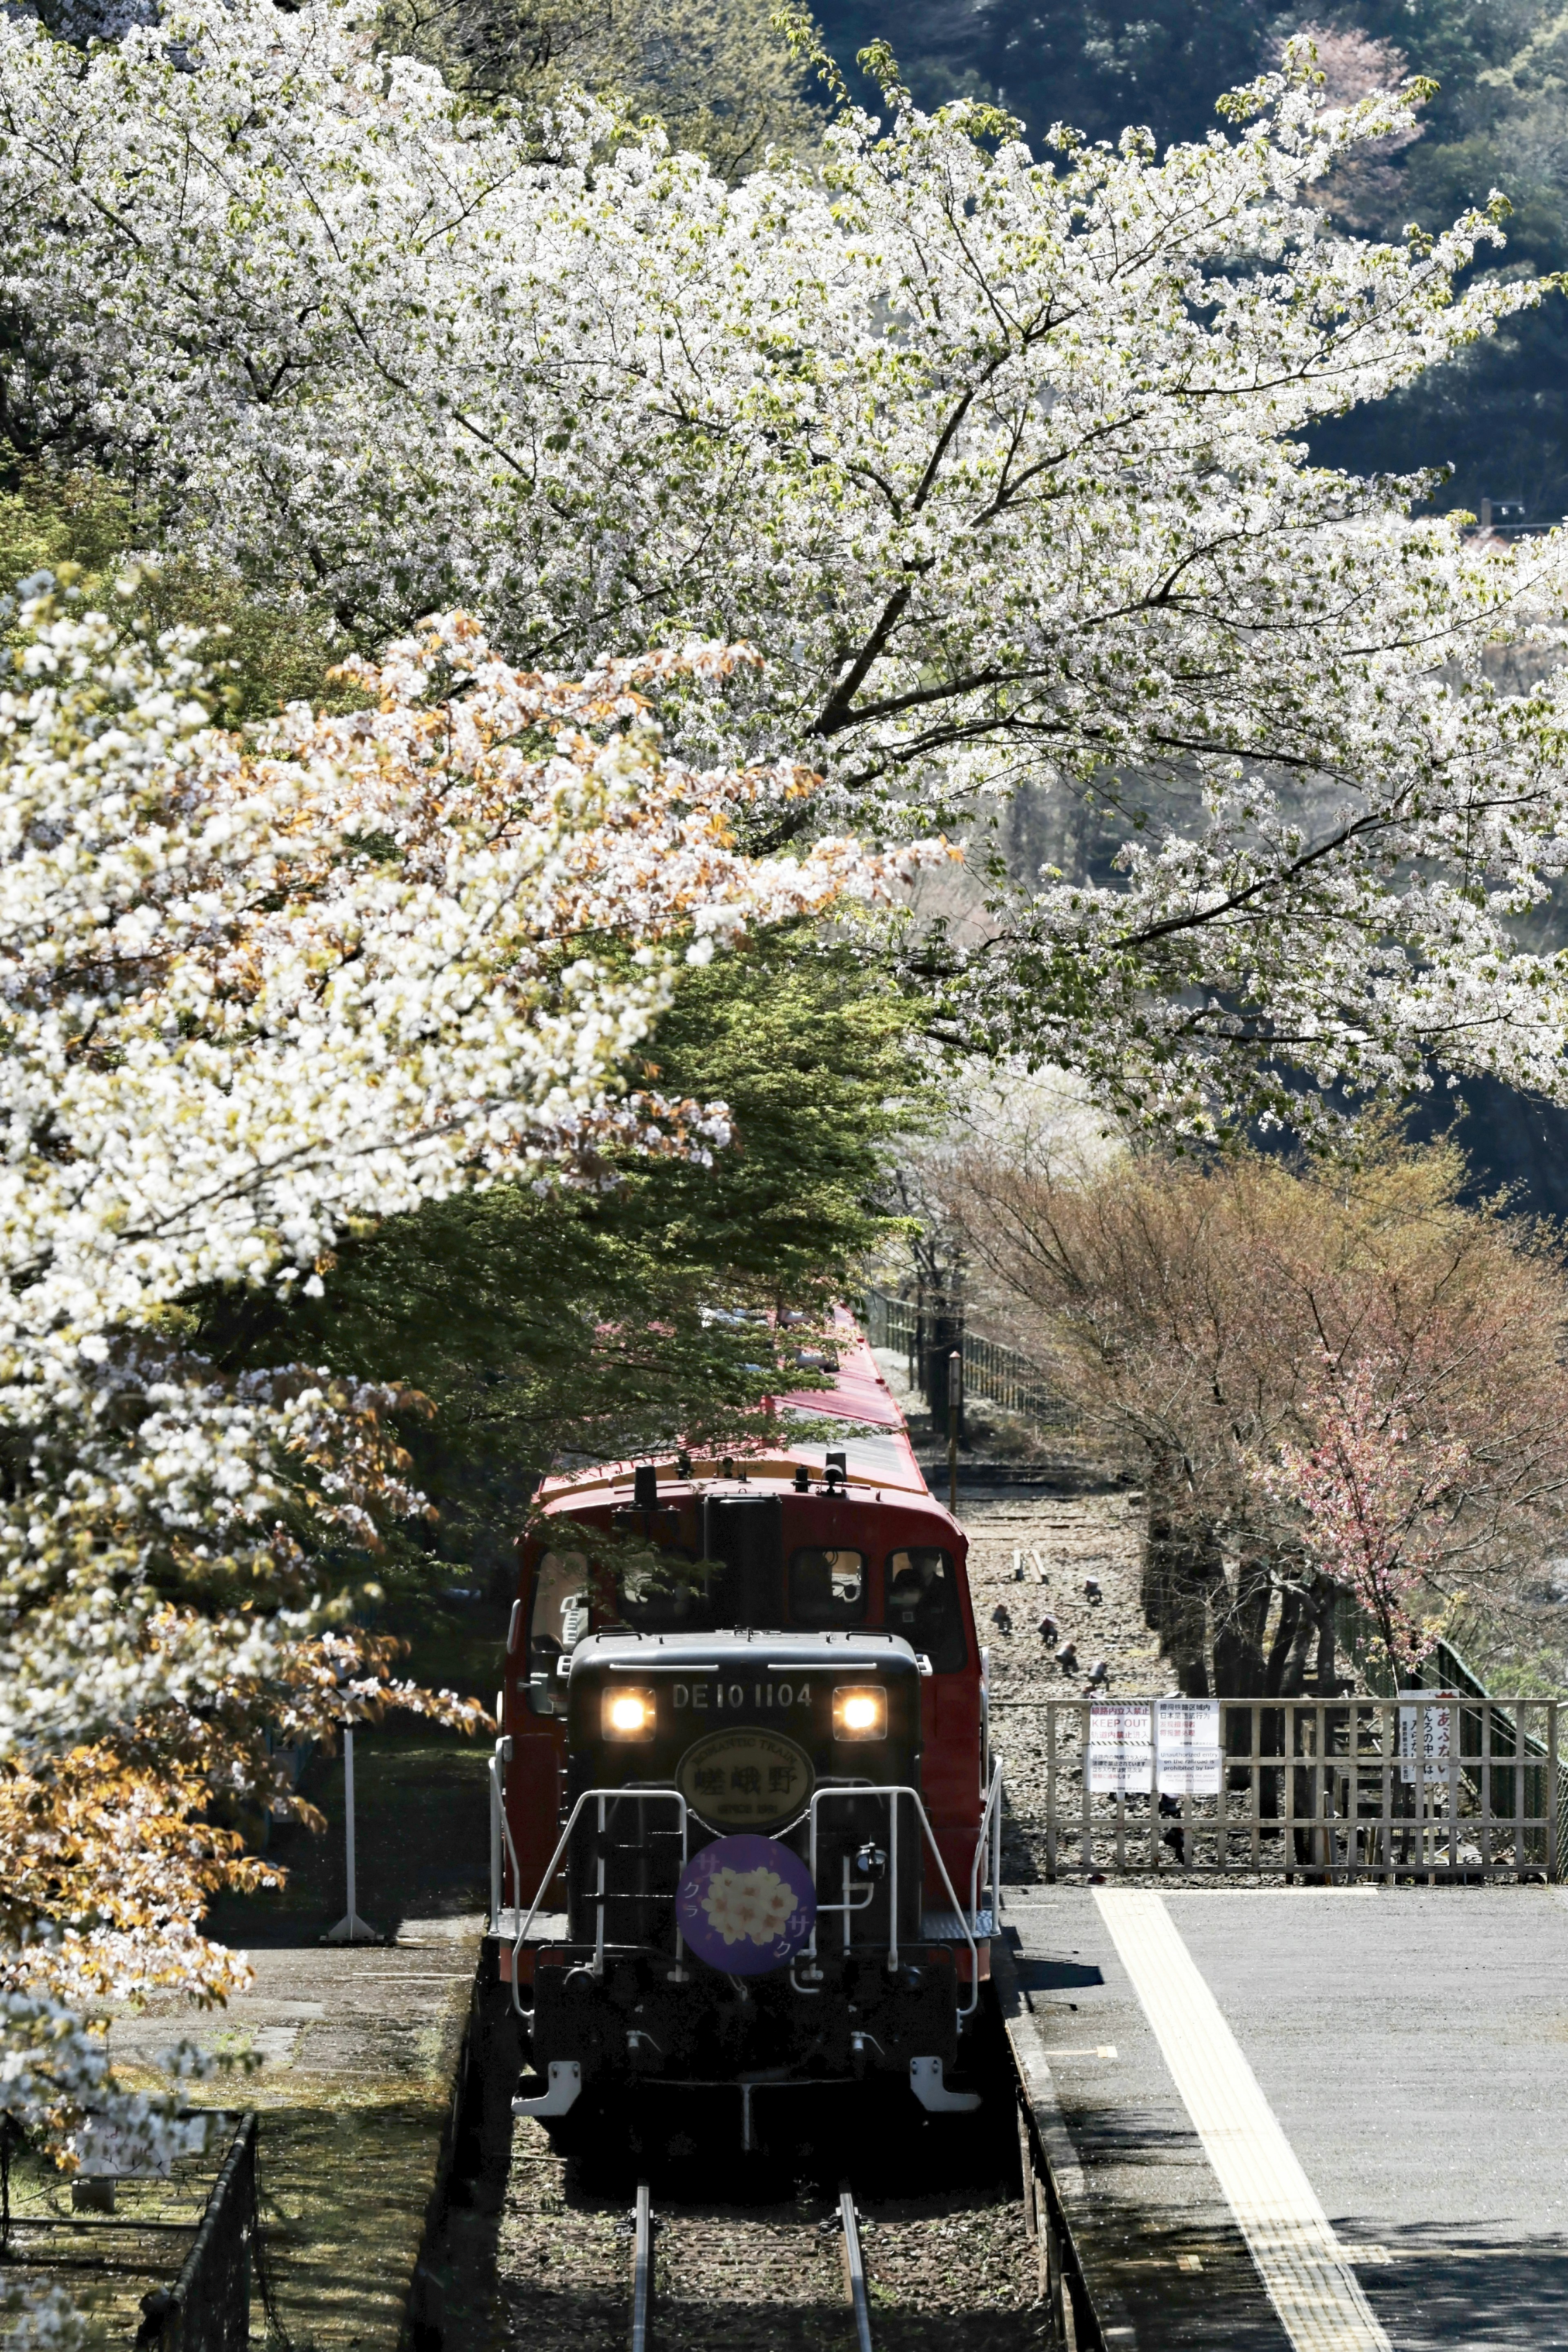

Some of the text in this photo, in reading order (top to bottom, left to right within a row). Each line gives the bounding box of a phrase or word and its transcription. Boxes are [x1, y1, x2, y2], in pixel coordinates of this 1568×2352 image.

[755, 1683, 812, 1707] 1104
[1091, 1707, 1150, 1715] 線路内立入禁止
[1092, 1719, 1148, 1728] KEEP OUT
[691, 1738, 797, 1766] ROMANTIC TRAIN
[693, 1765, 797, 1796] 嵯峨野
